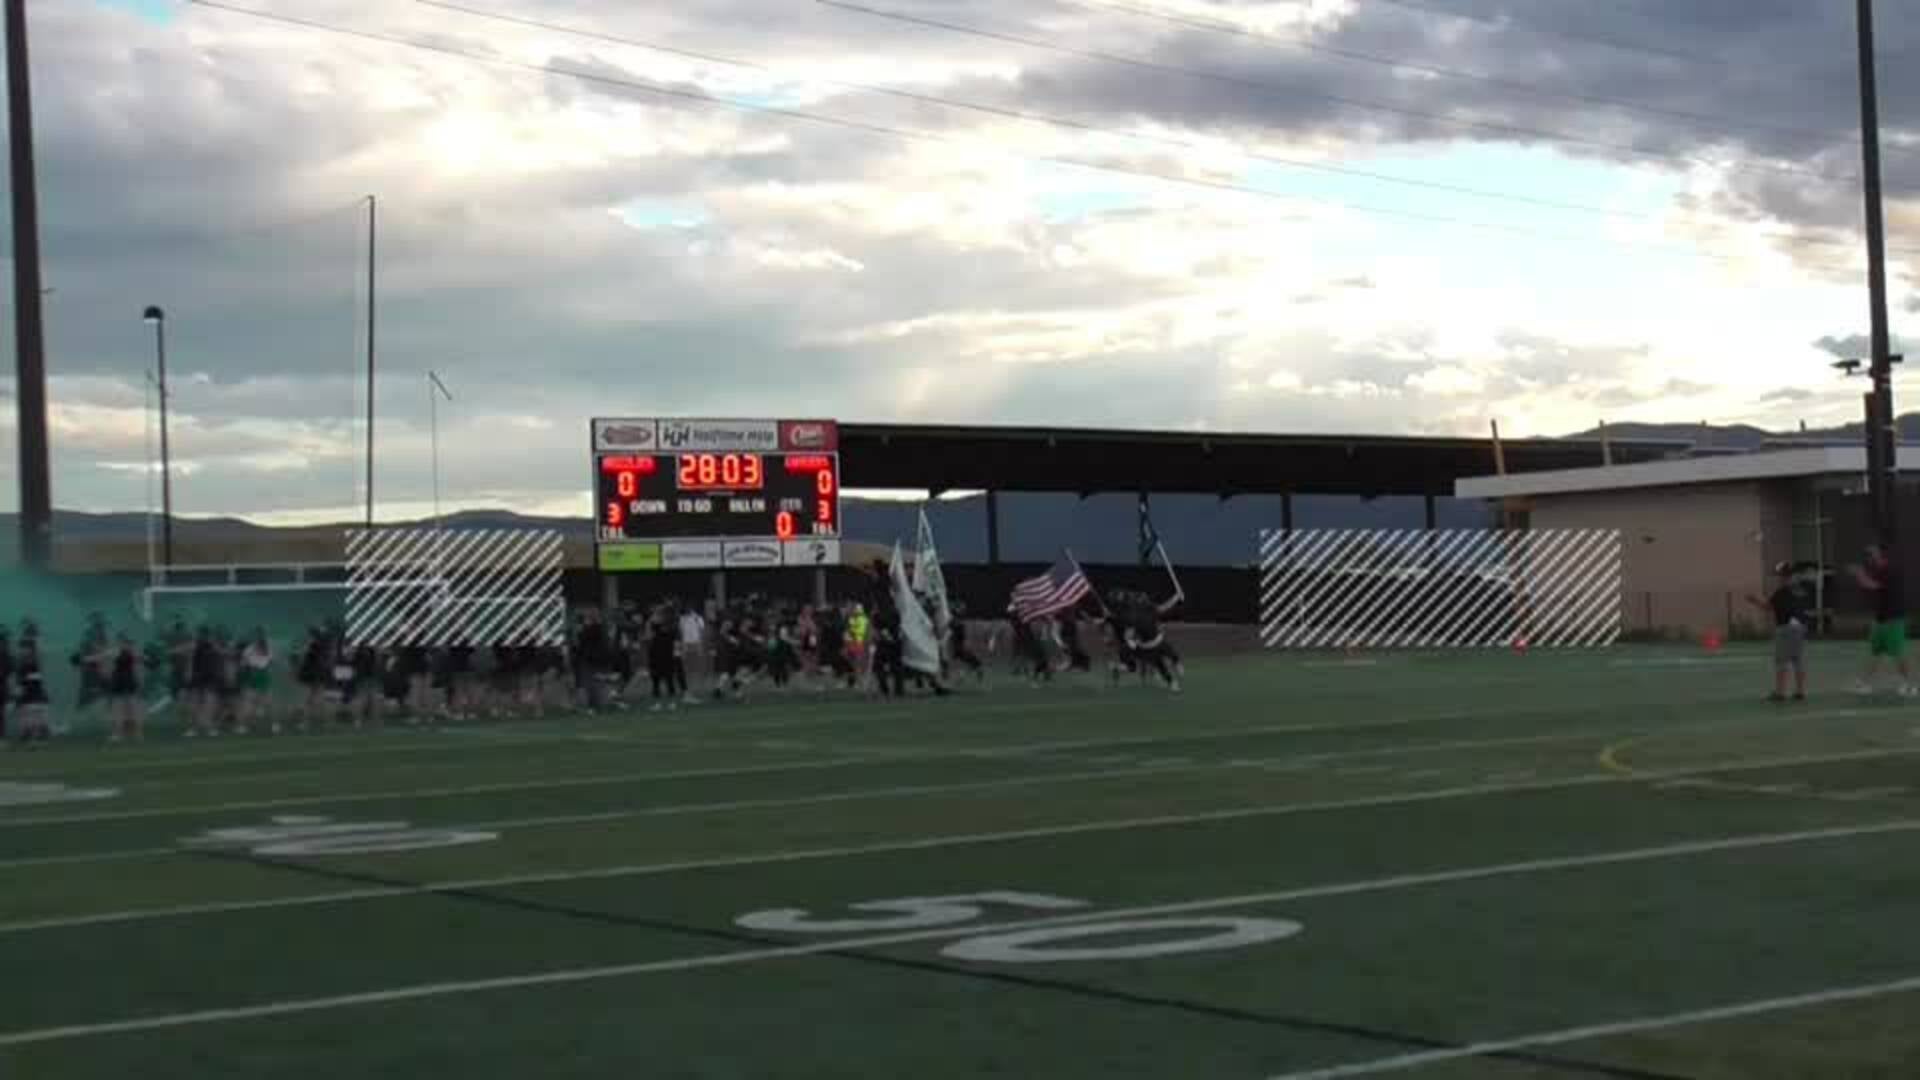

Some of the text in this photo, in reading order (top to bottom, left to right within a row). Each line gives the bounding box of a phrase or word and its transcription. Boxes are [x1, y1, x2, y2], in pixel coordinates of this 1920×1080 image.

[680, 455, 759, 484] 28:03
[618, 471, 634, 496] 0
[817, 470, 832, 494] 0
[608, 503, 621, 523] 3
[630, 500, 667, 514] DOWN
[694, 499, 712, 513] GO
[818, 500, 830, 519] 3
[776, 511, 792, 538] 0
[733, 891, 1303, 962] 50
